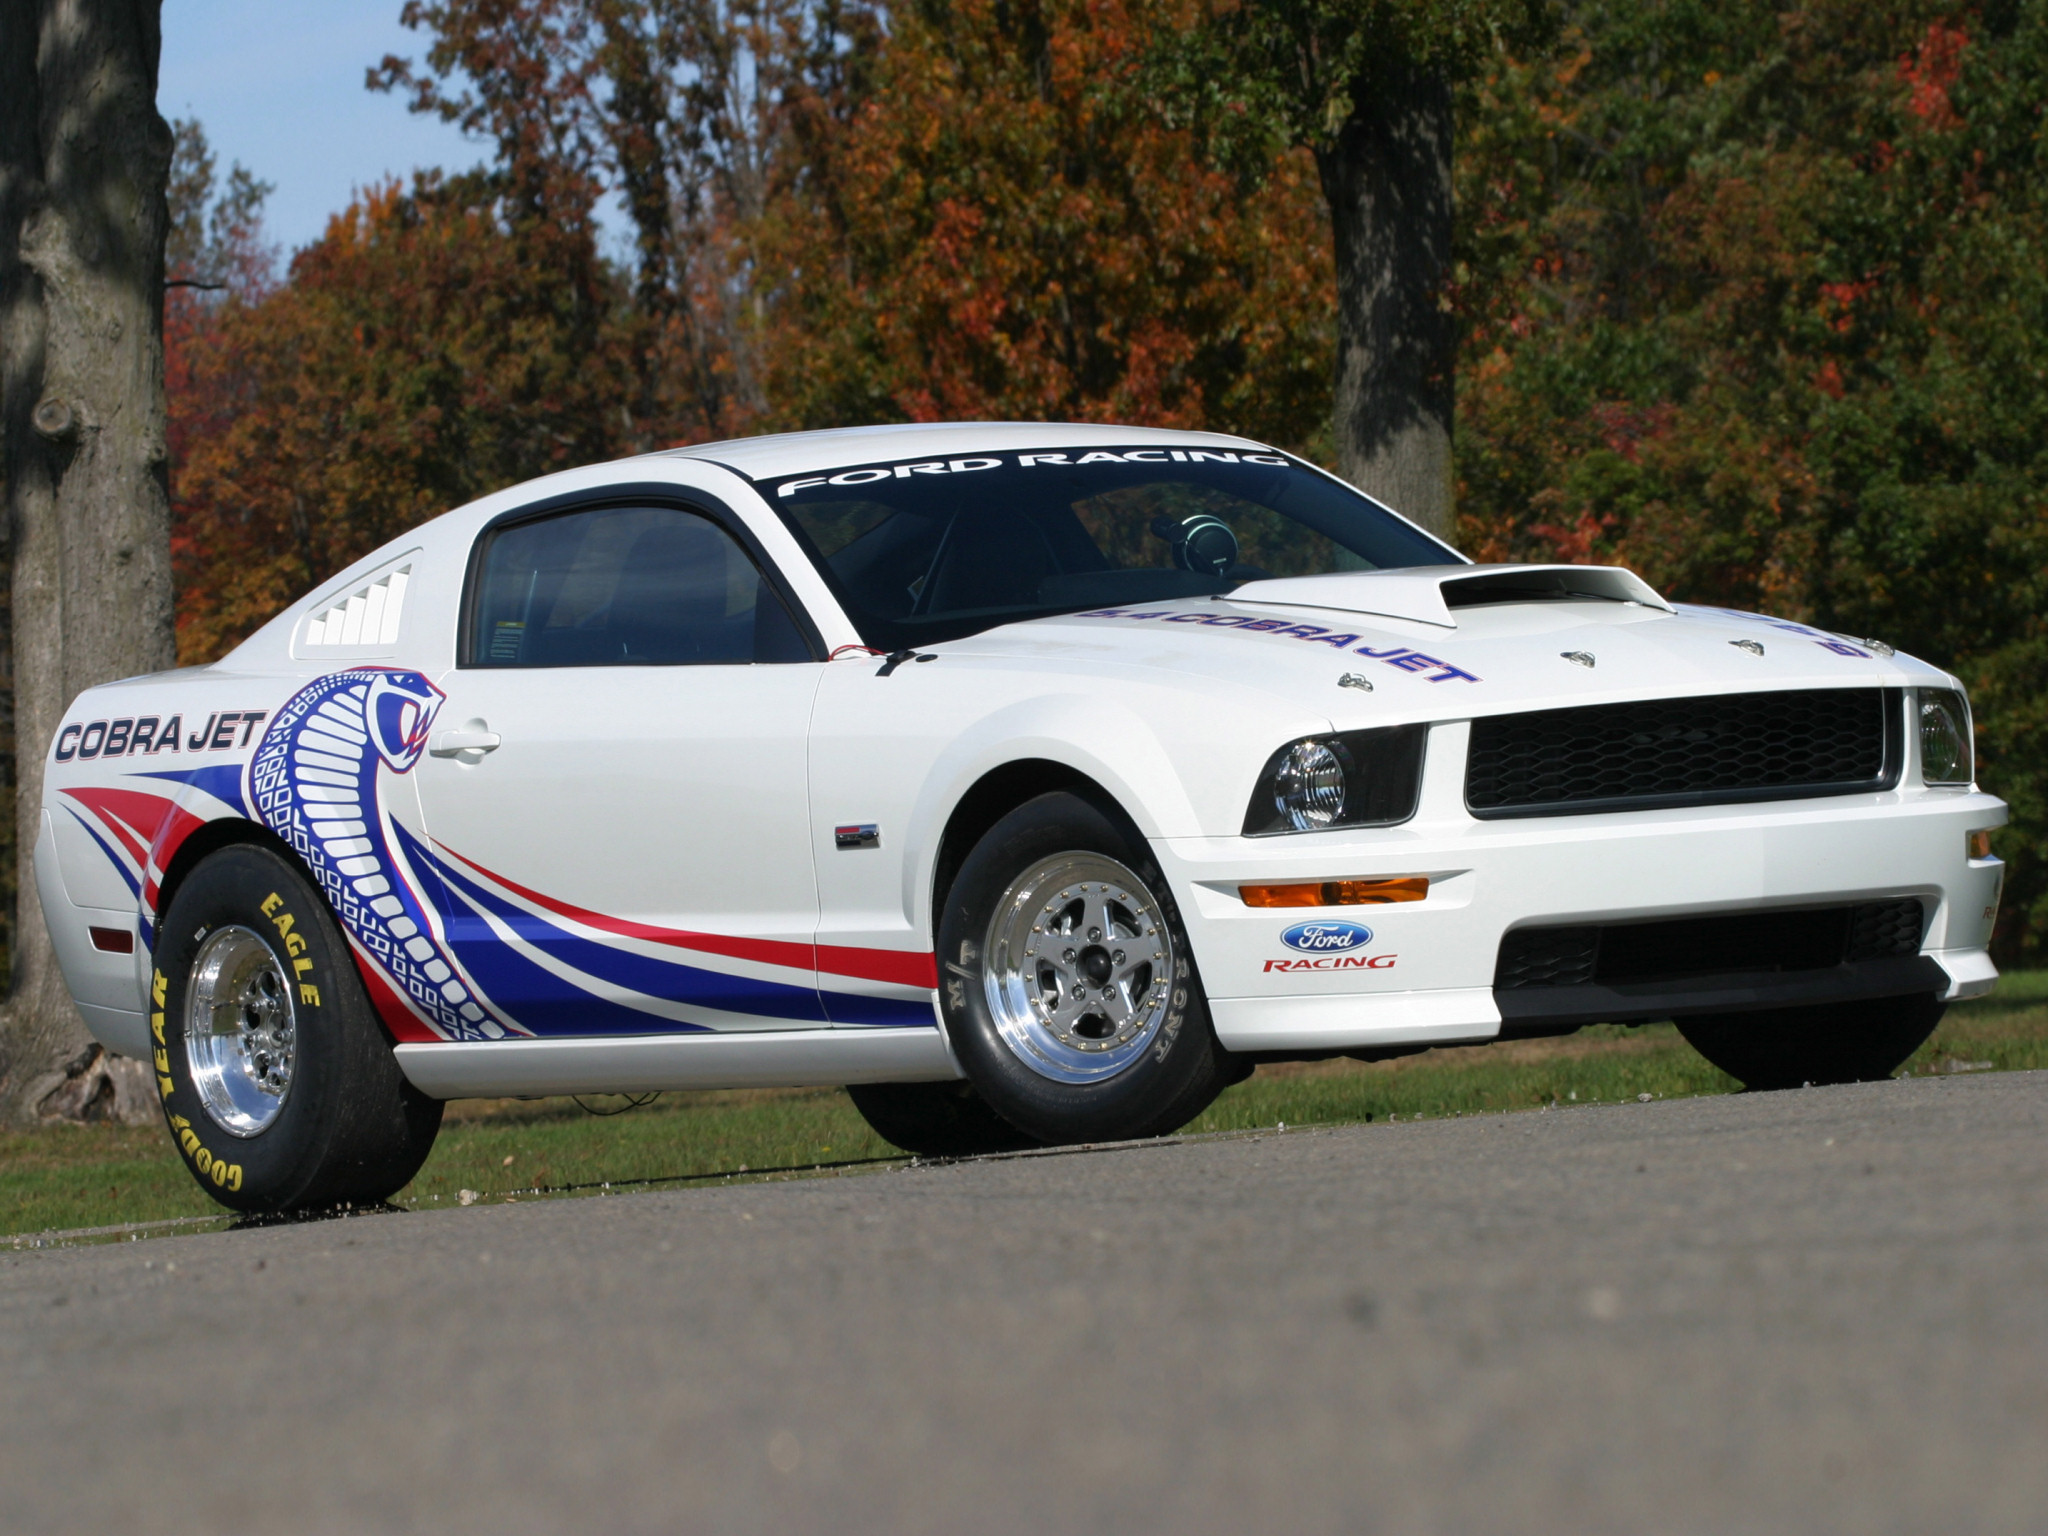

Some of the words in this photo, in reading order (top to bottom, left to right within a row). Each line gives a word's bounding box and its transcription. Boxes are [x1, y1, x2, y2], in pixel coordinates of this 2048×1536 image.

[777, 457, 1003, 498] FORD
[1018, 450, 1290, 468] RACING
[1161, 612, 1364, 650] COBRA
[1352, 644, 1483, 685] JET
[55, 713, 184, 763] COBRA
[187, 709, 271, 752] JET
[259, 892, 321, 1008] EAGLE
[1298, 925, 1354, 948] Ford
[1262, 954, 1398, 973] RACING
